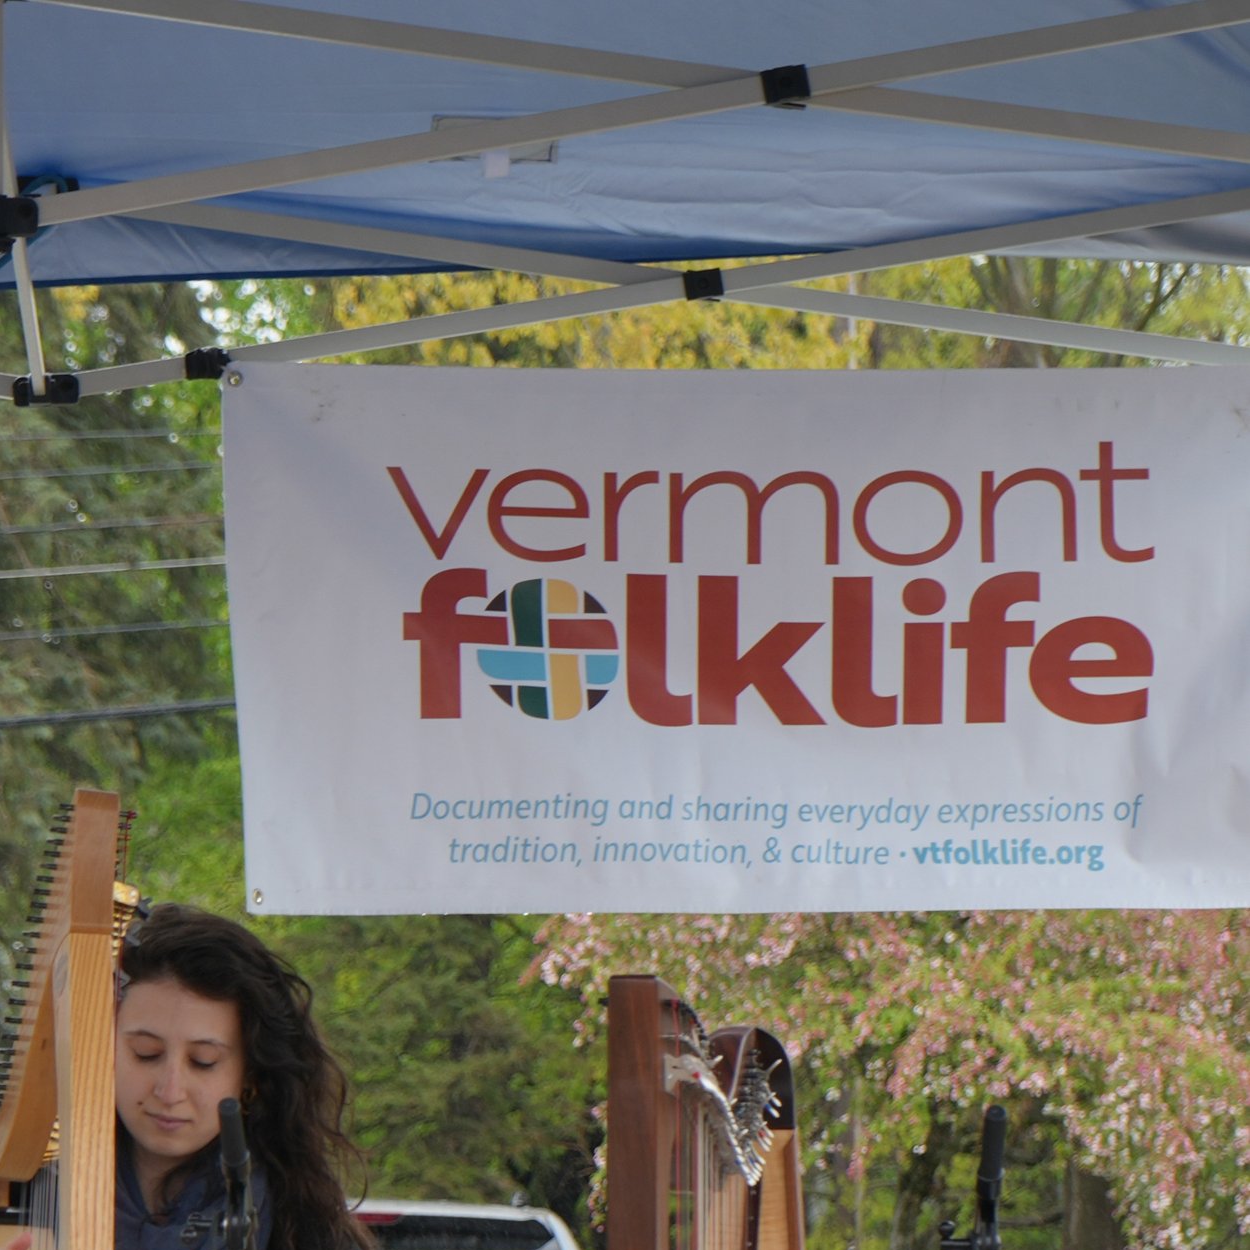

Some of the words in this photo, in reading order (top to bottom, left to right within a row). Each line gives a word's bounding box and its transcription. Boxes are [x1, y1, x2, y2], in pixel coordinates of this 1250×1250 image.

[386, 441, 1155, 566] vermont
[403, 567, 1154, 728] folklife
[410, 792, 609, 827] Documenting
[618, 794, 674, 820] and
[682, 796, 789, 829] sharing
[798, 797, 931, 831] everyday
[937, 796, 1105, 830] expressions
[1113, 793, 1145, 829] of
[448, 836, 583, 867] tradition,
[593, 836, 752, 869] innovation,
[761, 837, 782, 863] &
[791, 838, 890, 865] culture
[912, 838, 1105, 872] vtfolklife.org
